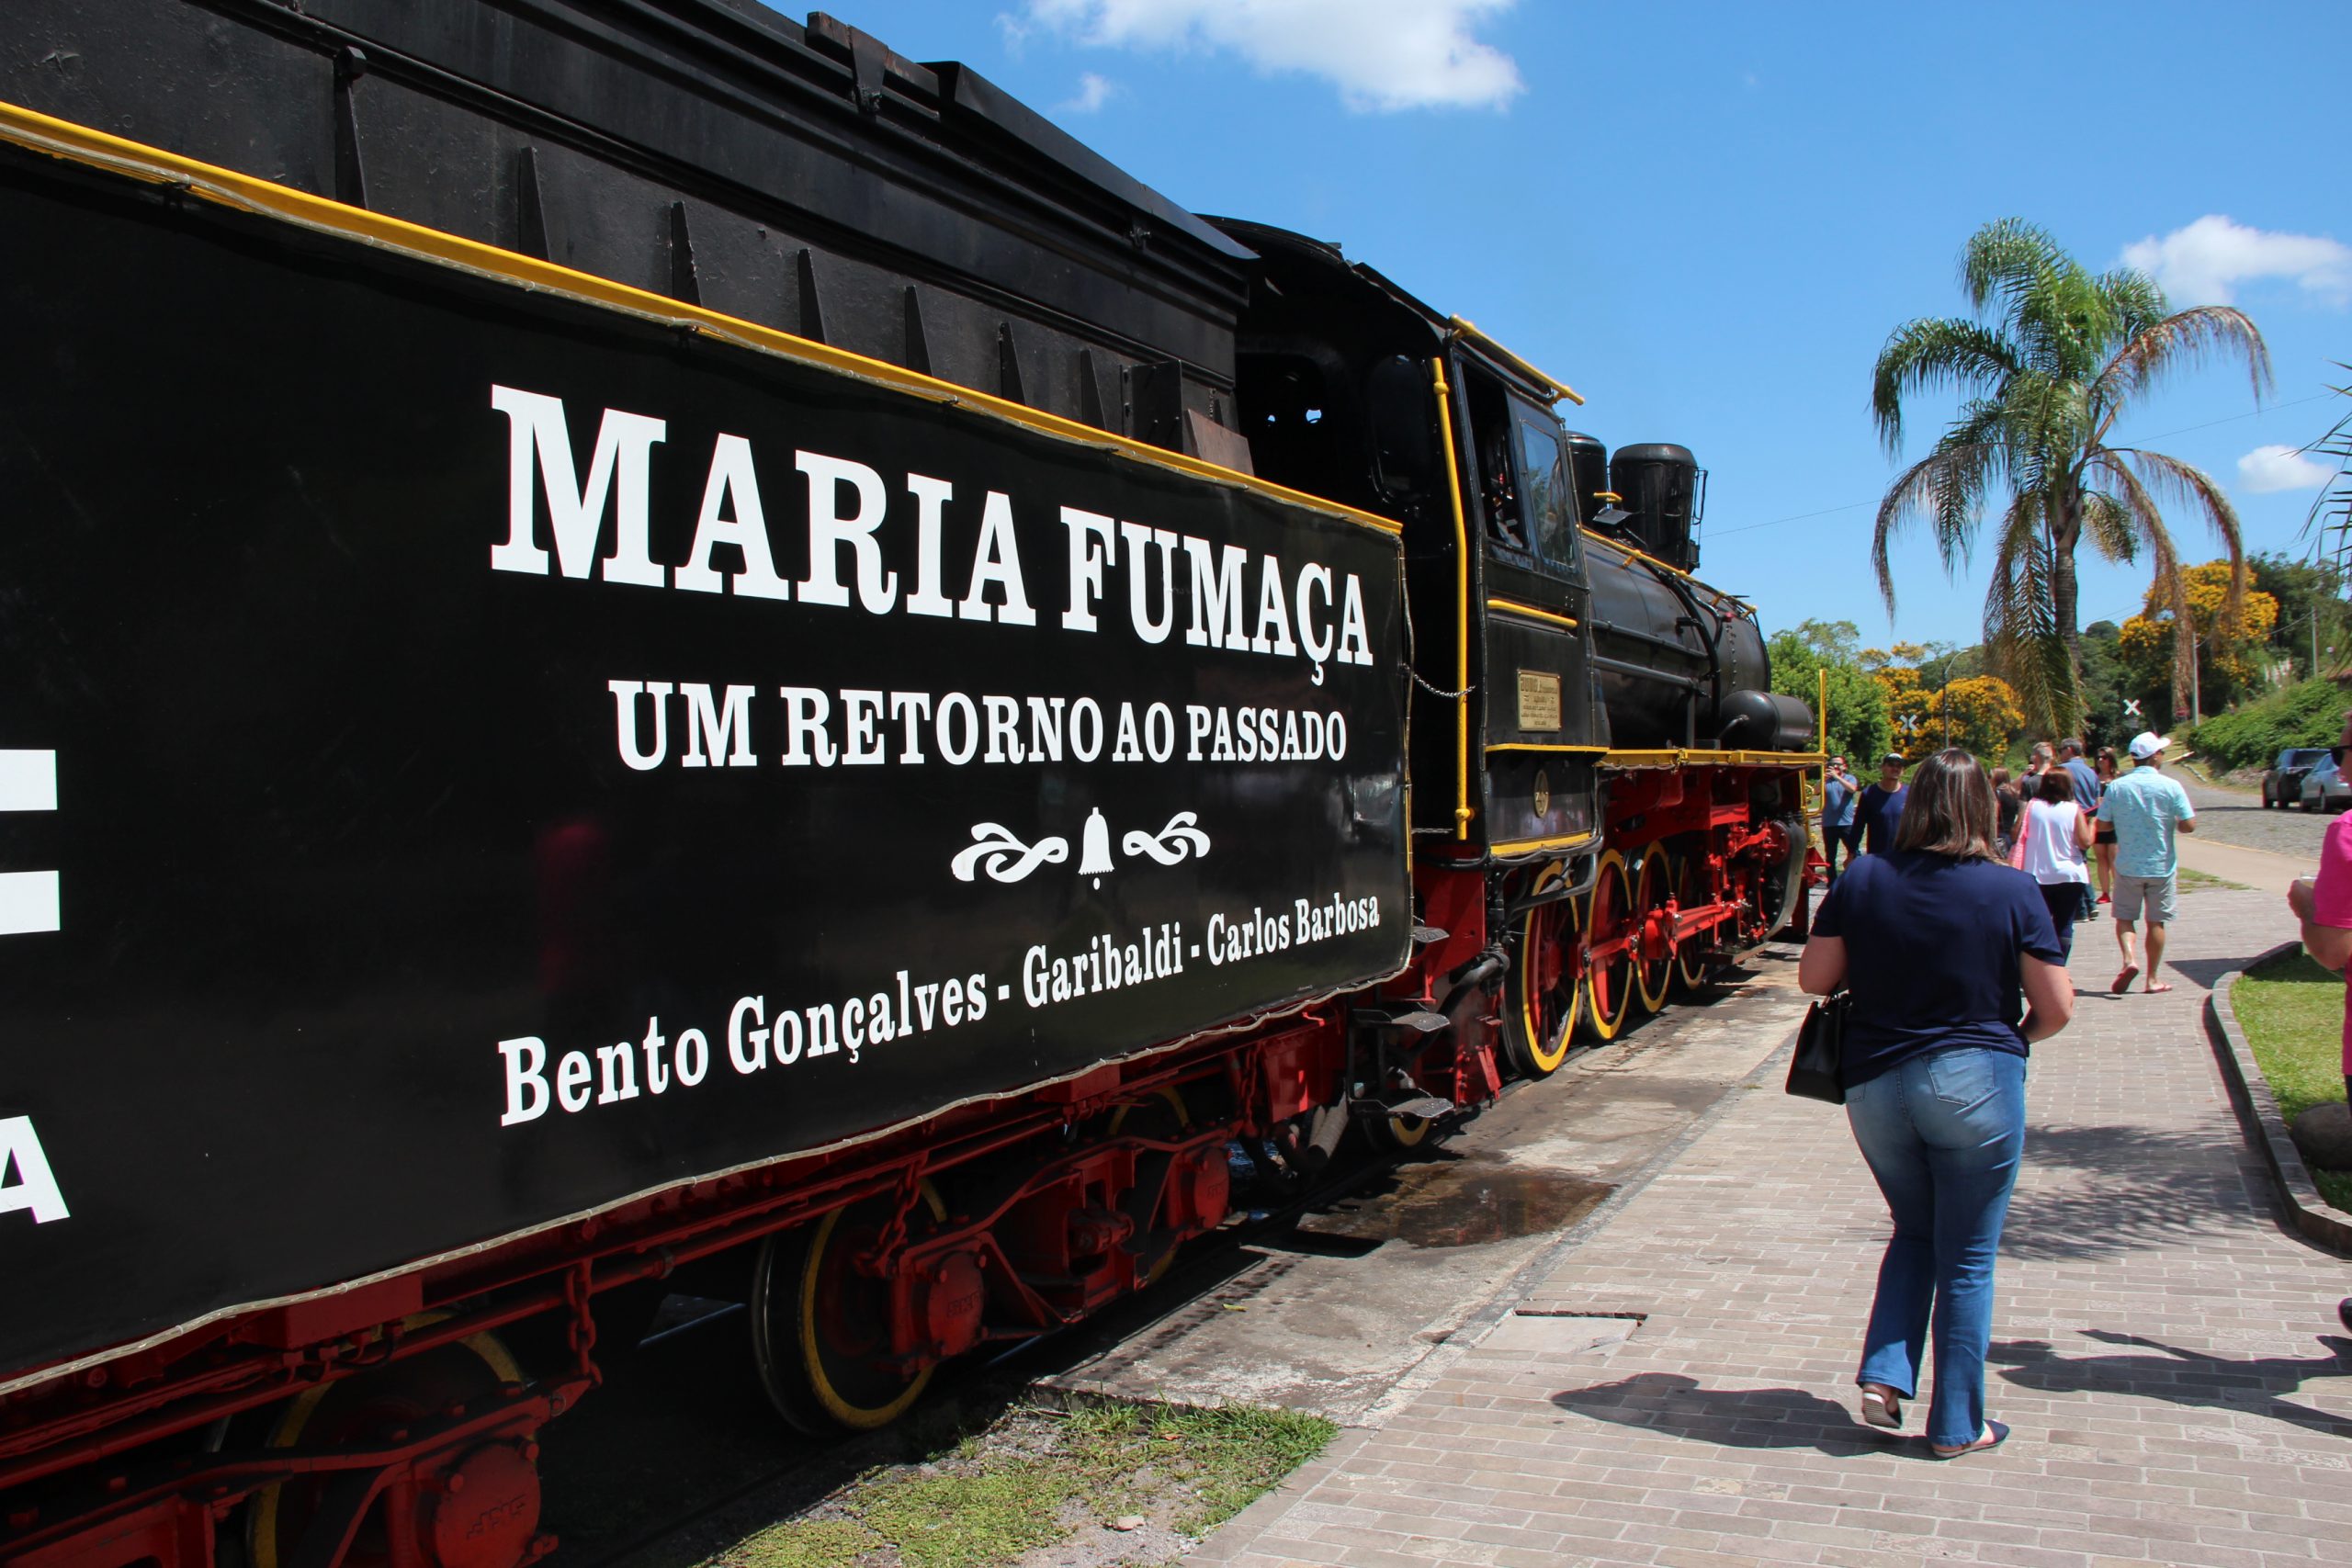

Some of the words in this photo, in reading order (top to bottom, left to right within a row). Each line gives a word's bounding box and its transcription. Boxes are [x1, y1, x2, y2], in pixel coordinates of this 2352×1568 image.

[491, 384, 1036, 626] MARIA
[1059, 505, 1374, 687] FUMAÇA
[607, 680, 758, 771] UM
[780, 686, 1103, 767] RETORNO
[1112, 702, 1175, 763] AO
[1185, 705, 1348, 762] PASSADO
[498, 1016, 709, 1127] Bento
[728, 969, 989, 1075] Gonçalves
[1023, 921, 1183, 1008] Garibaldi
[1206, 907, 1290, 966] Carlos
[1295, 891, 1380, 946] Barbosa
